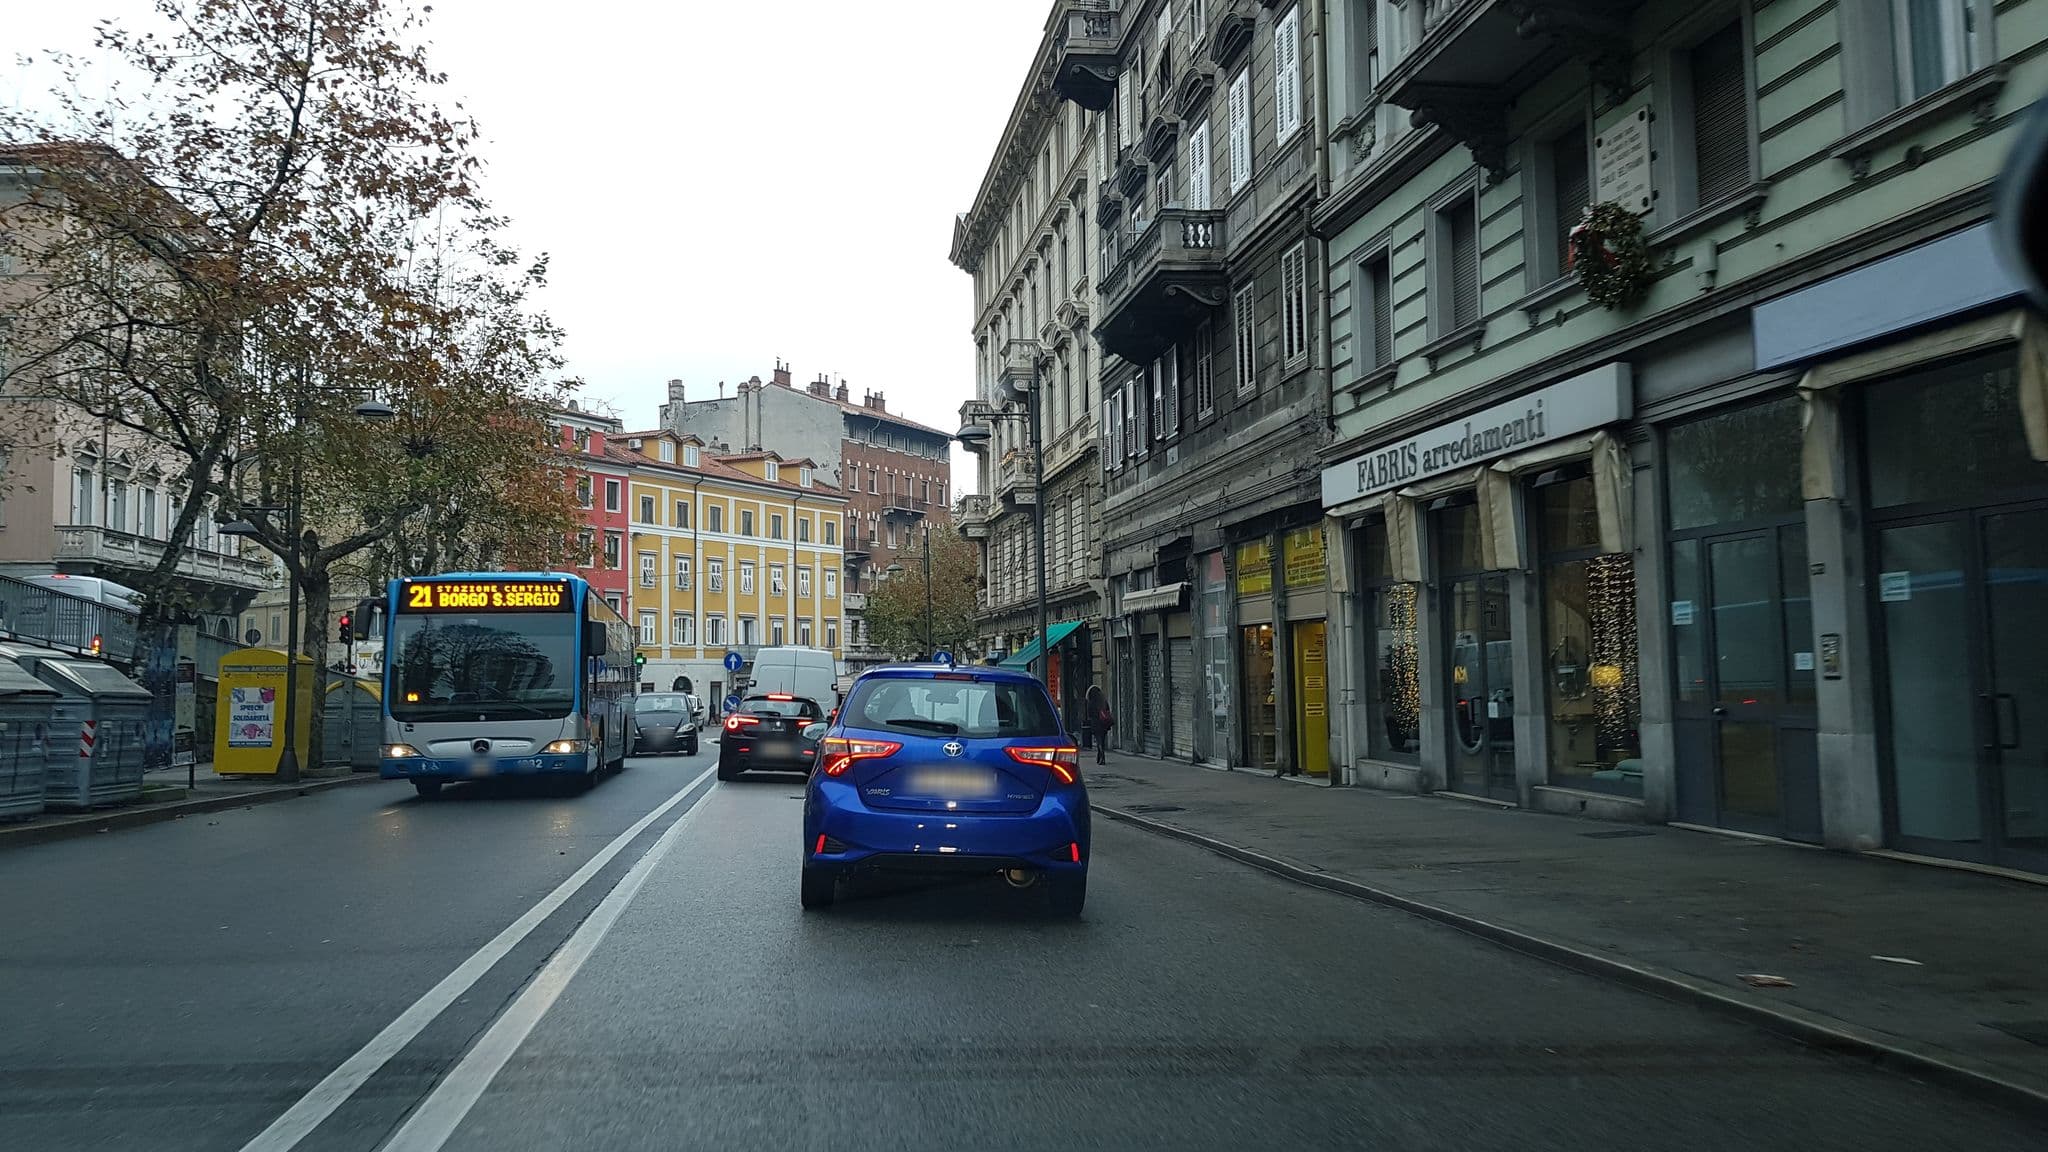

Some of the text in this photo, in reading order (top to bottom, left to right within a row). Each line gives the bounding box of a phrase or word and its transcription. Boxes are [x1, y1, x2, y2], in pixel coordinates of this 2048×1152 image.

[1356, 399, 1546, 493] FABRIS arredamenti
[409, 585, 433, 607] 21
[436, 585, 498, 593] STAZIONE
[439, 592, 560, 607] BORGO S.SERGIO
